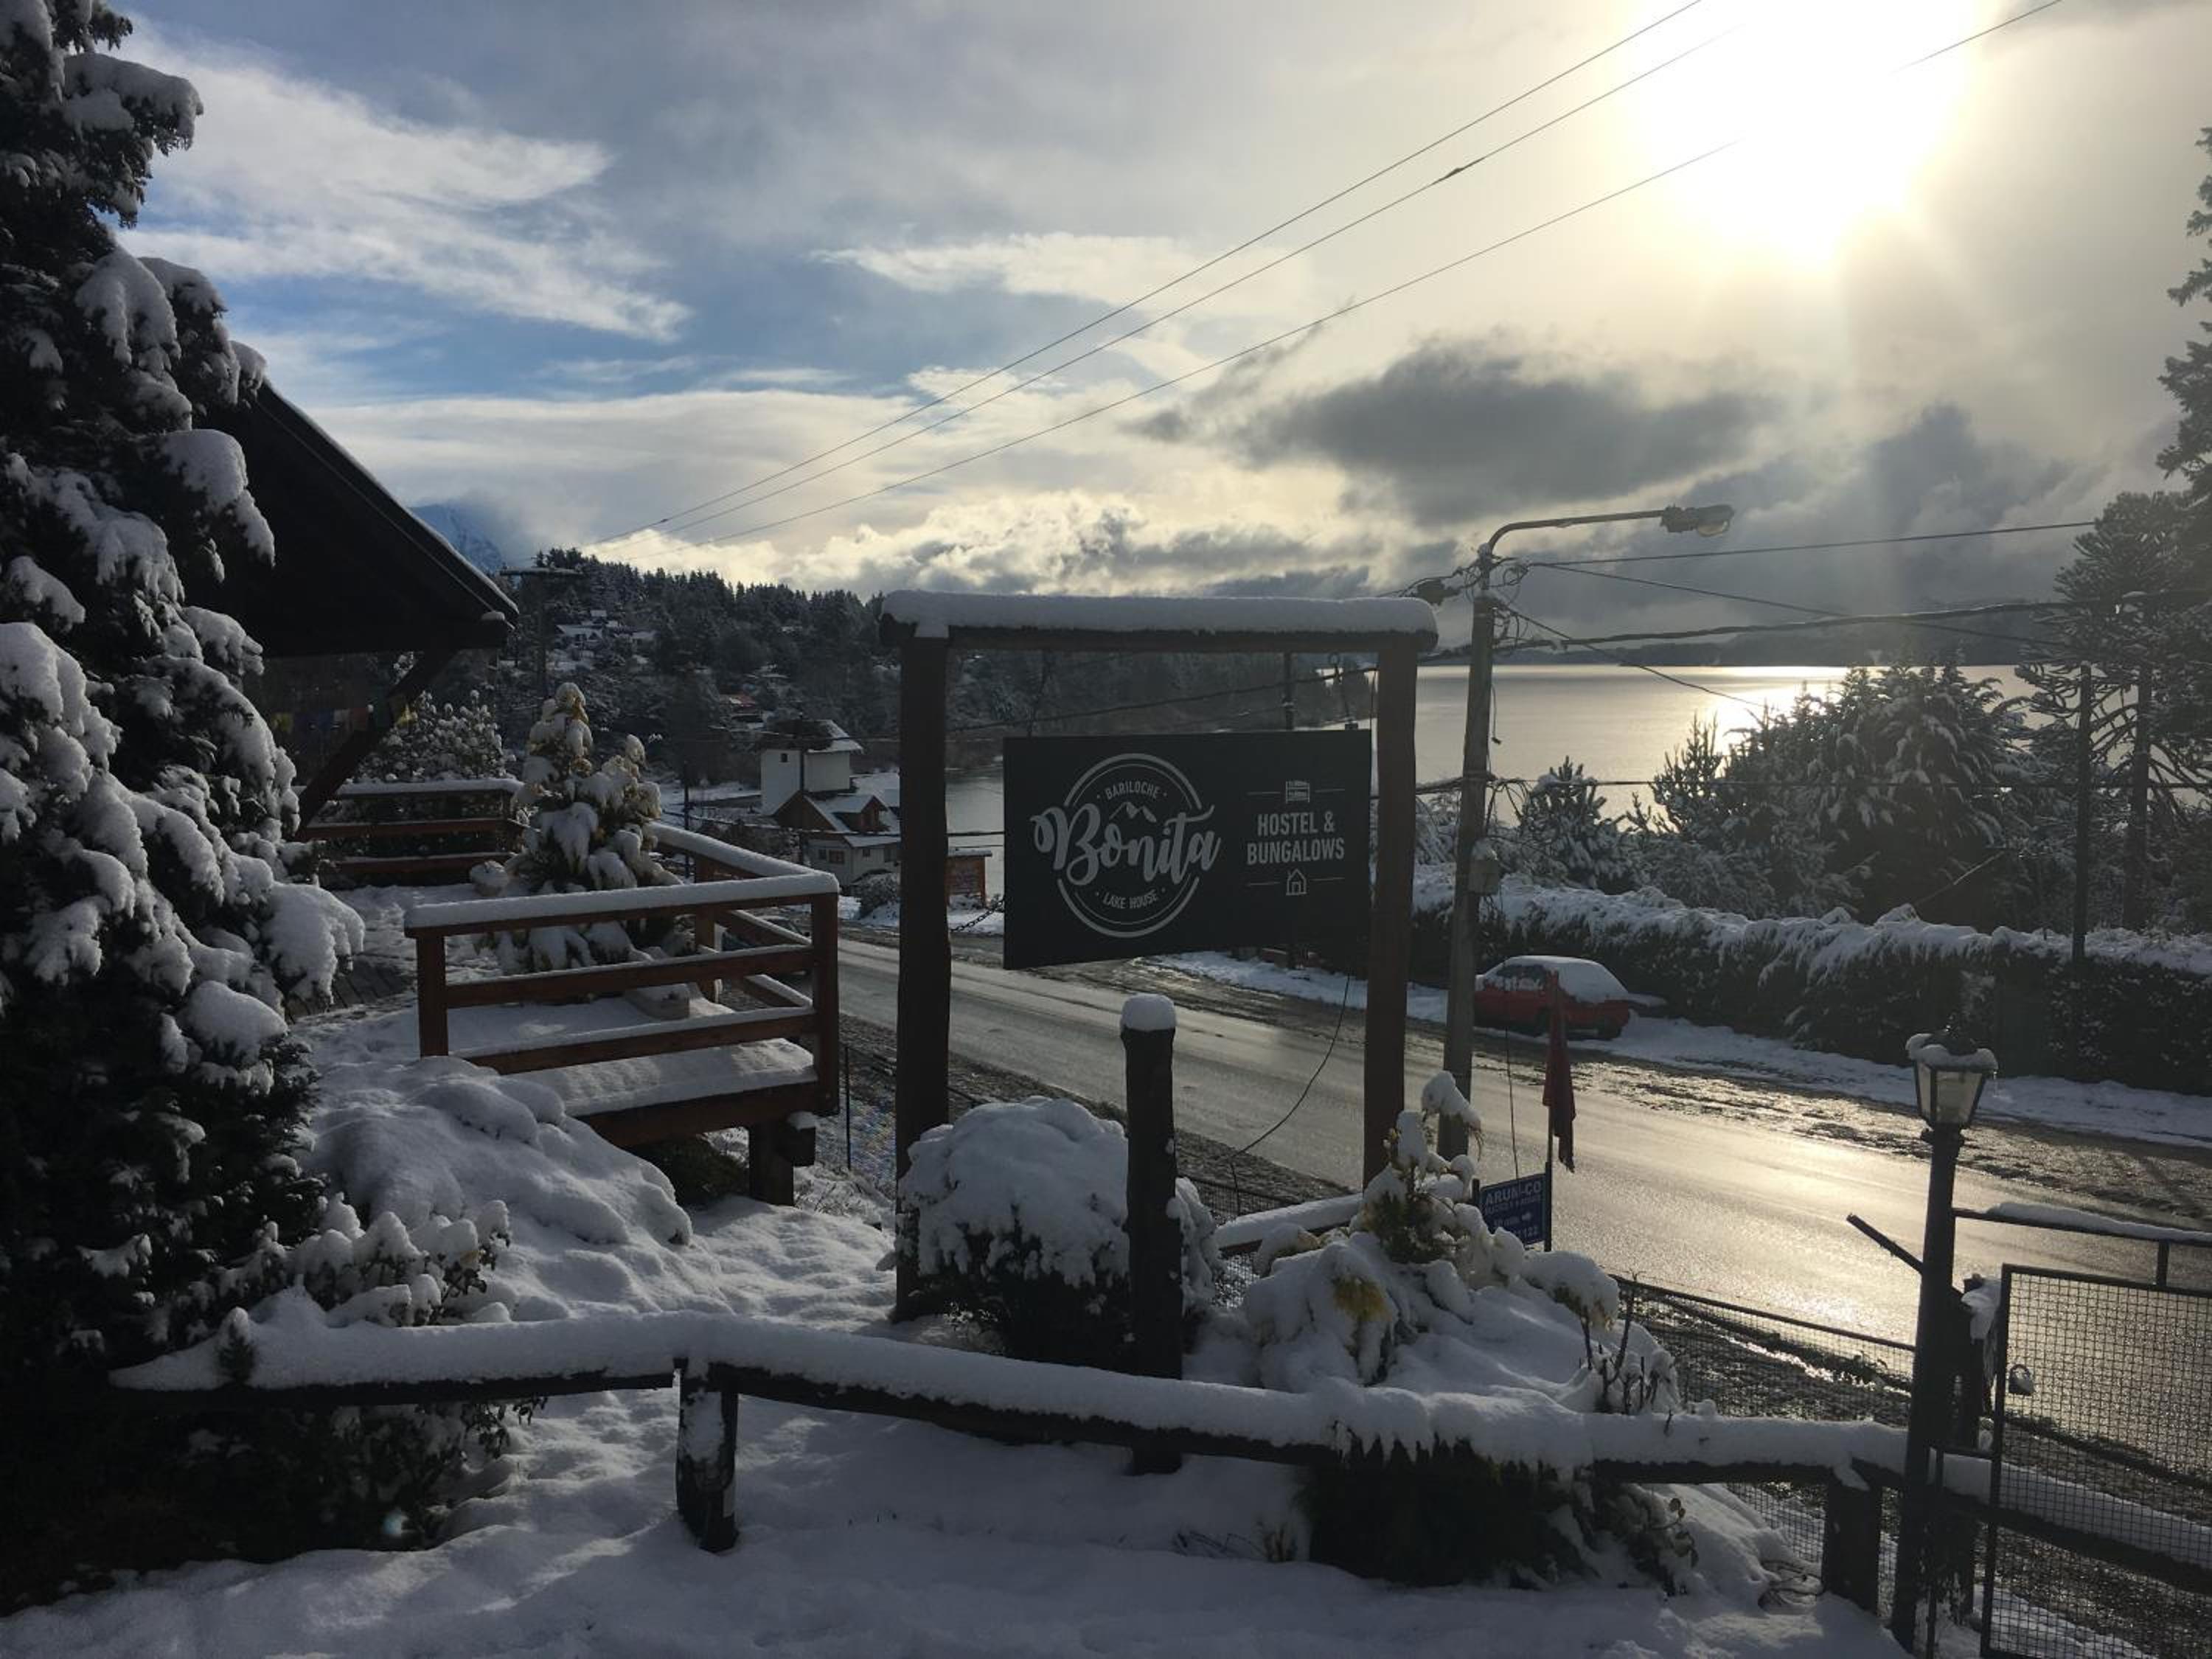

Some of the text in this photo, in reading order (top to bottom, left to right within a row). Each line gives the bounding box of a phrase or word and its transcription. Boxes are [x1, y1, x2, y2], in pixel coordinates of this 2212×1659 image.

[1105, 781, 1161, 800] BARILOCHE
[1257, 810, 1335, 836] HOSTEL &
[1030, 803, 1222, 886] Bonita
[1247, 837, 1345, 865] BUNGALOWS
[1103, 888, 1158, 909] LAKE HOUSE
